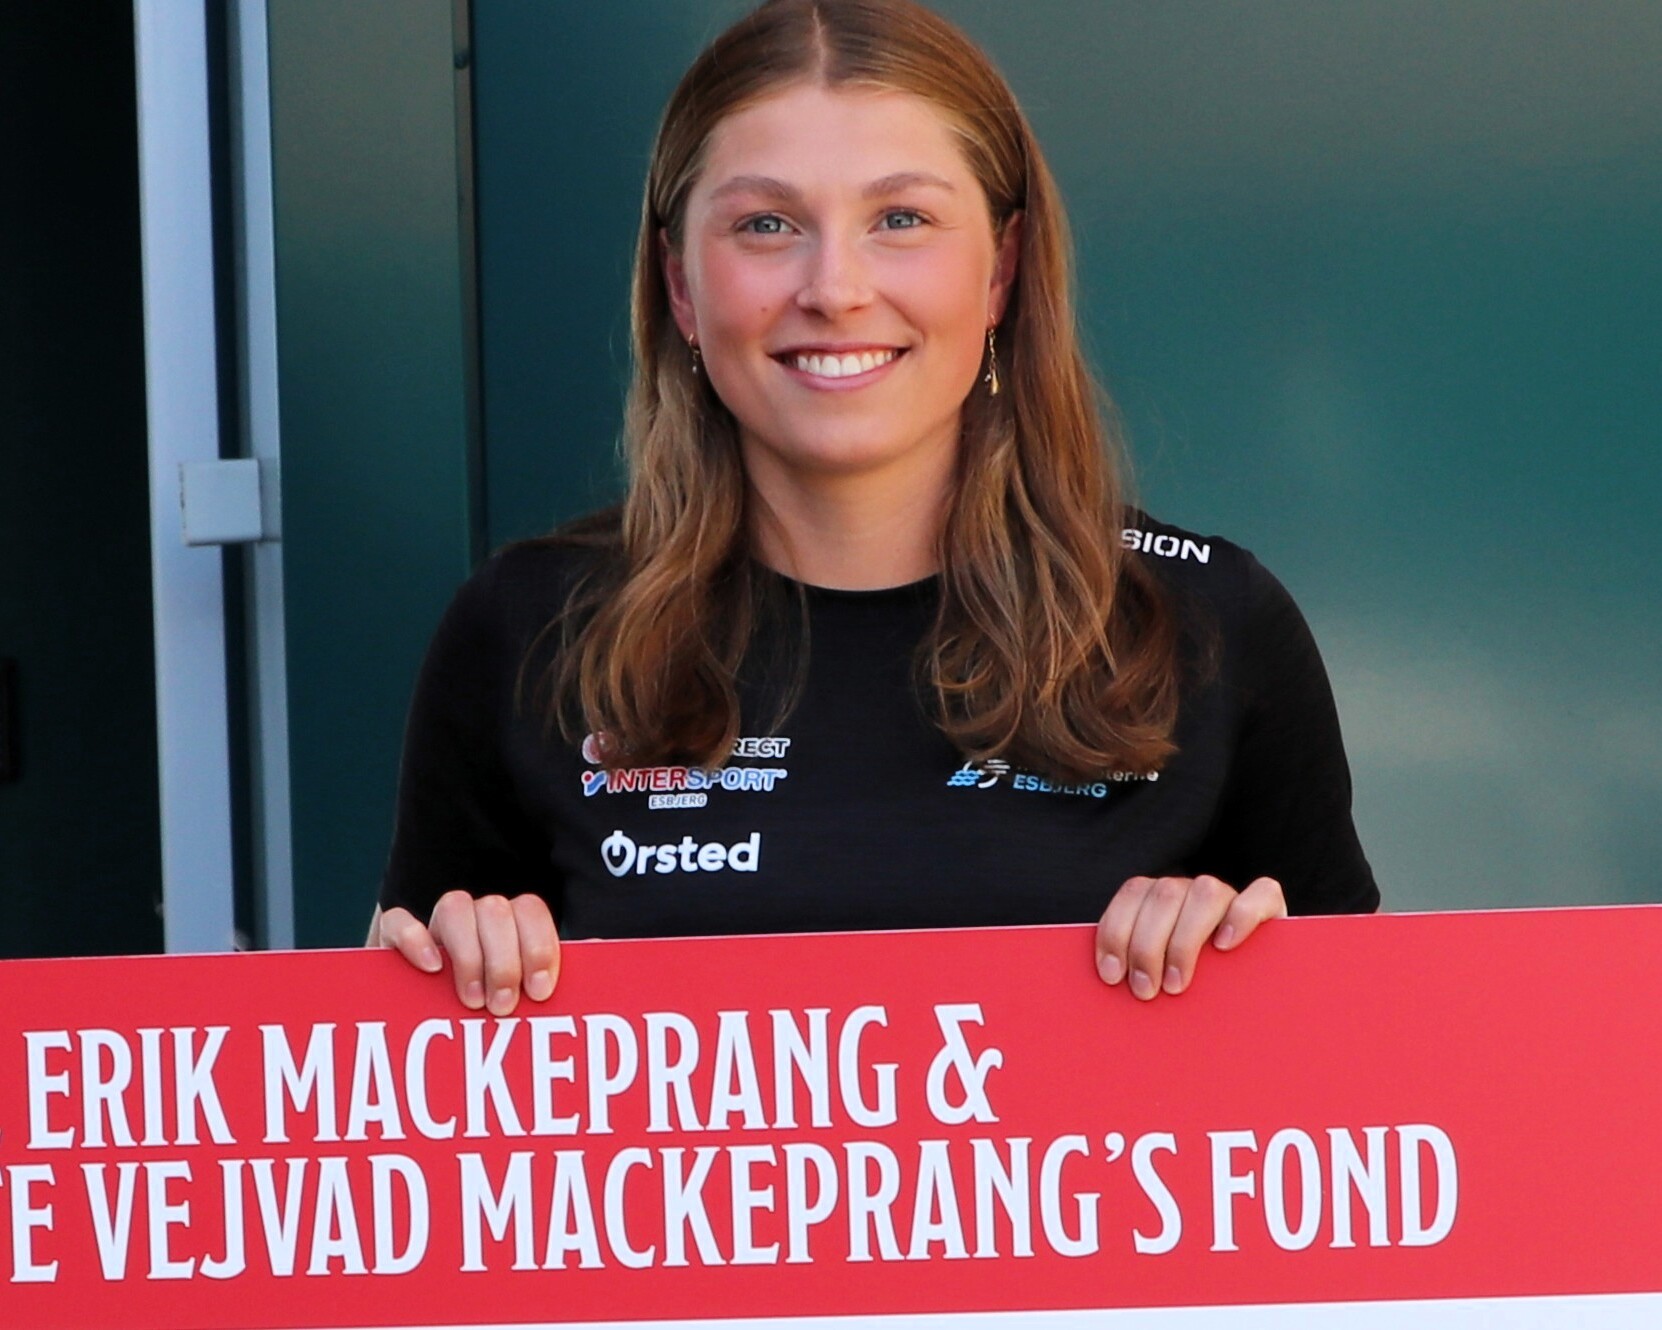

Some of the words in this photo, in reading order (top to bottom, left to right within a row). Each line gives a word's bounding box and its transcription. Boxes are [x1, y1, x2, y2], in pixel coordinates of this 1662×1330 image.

[606, 766, 777, 793] INTERSPORT
[649, 793, 707, 809] ESBJERG
[601, 830, 760, 877] Ørsted
[22, 1026, 237, 1149] ERIK
[258, 1005, 900, 1144] MACKEPRANG
[925, 1003, 1004, 1125] &
[0, 1164, 59, 1283] E
[80, 1153, 431, 1281] VEJVAD
[1206, 1124, 1459, 1252] FOND
